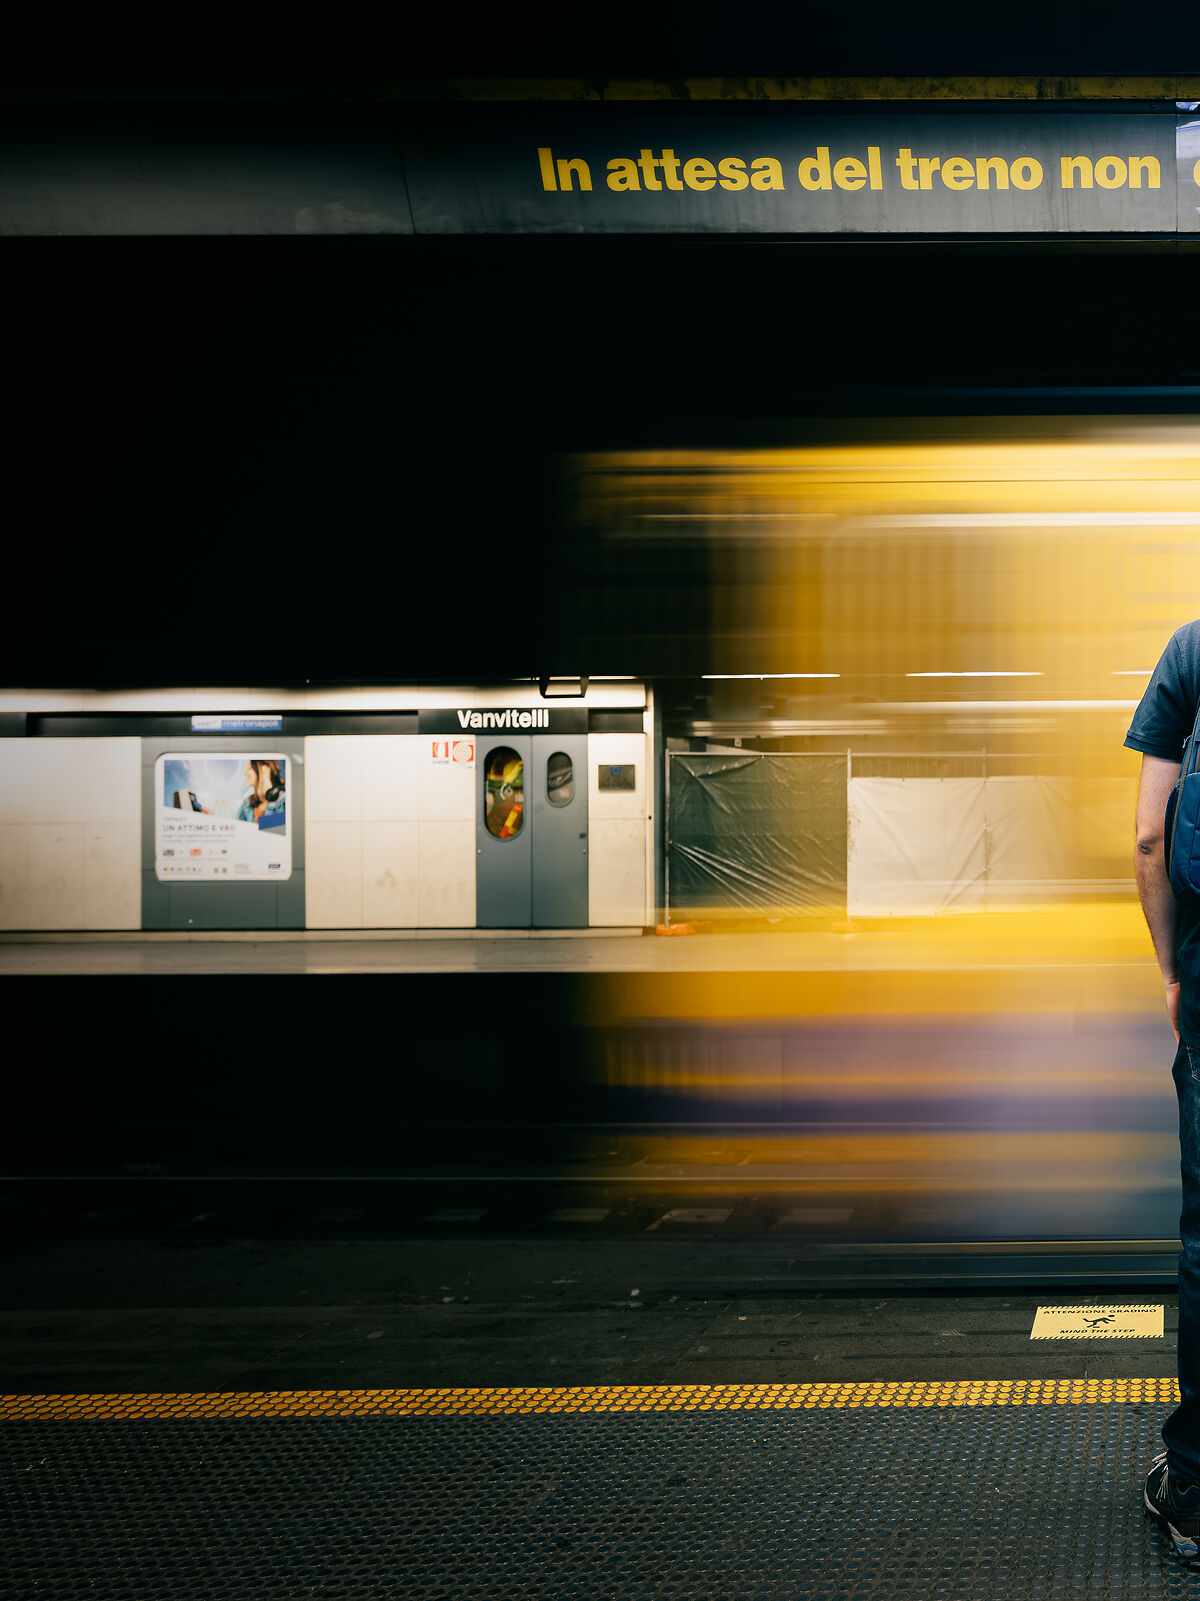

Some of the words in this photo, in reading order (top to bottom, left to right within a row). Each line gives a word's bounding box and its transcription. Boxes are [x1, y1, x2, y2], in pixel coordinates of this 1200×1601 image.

[538, 147, 593, 191] In
[606, 149, 786, 191] attesa
[798, 146, 883, 191] del
[896, 148, 1044, 191] treno
[1060, 155, 1161, 189] non
[457, 708, 550, 729] Vanvitelli
[162, 824, 175, 832] UN
[177, 824, 210, 832] ATTIMO
